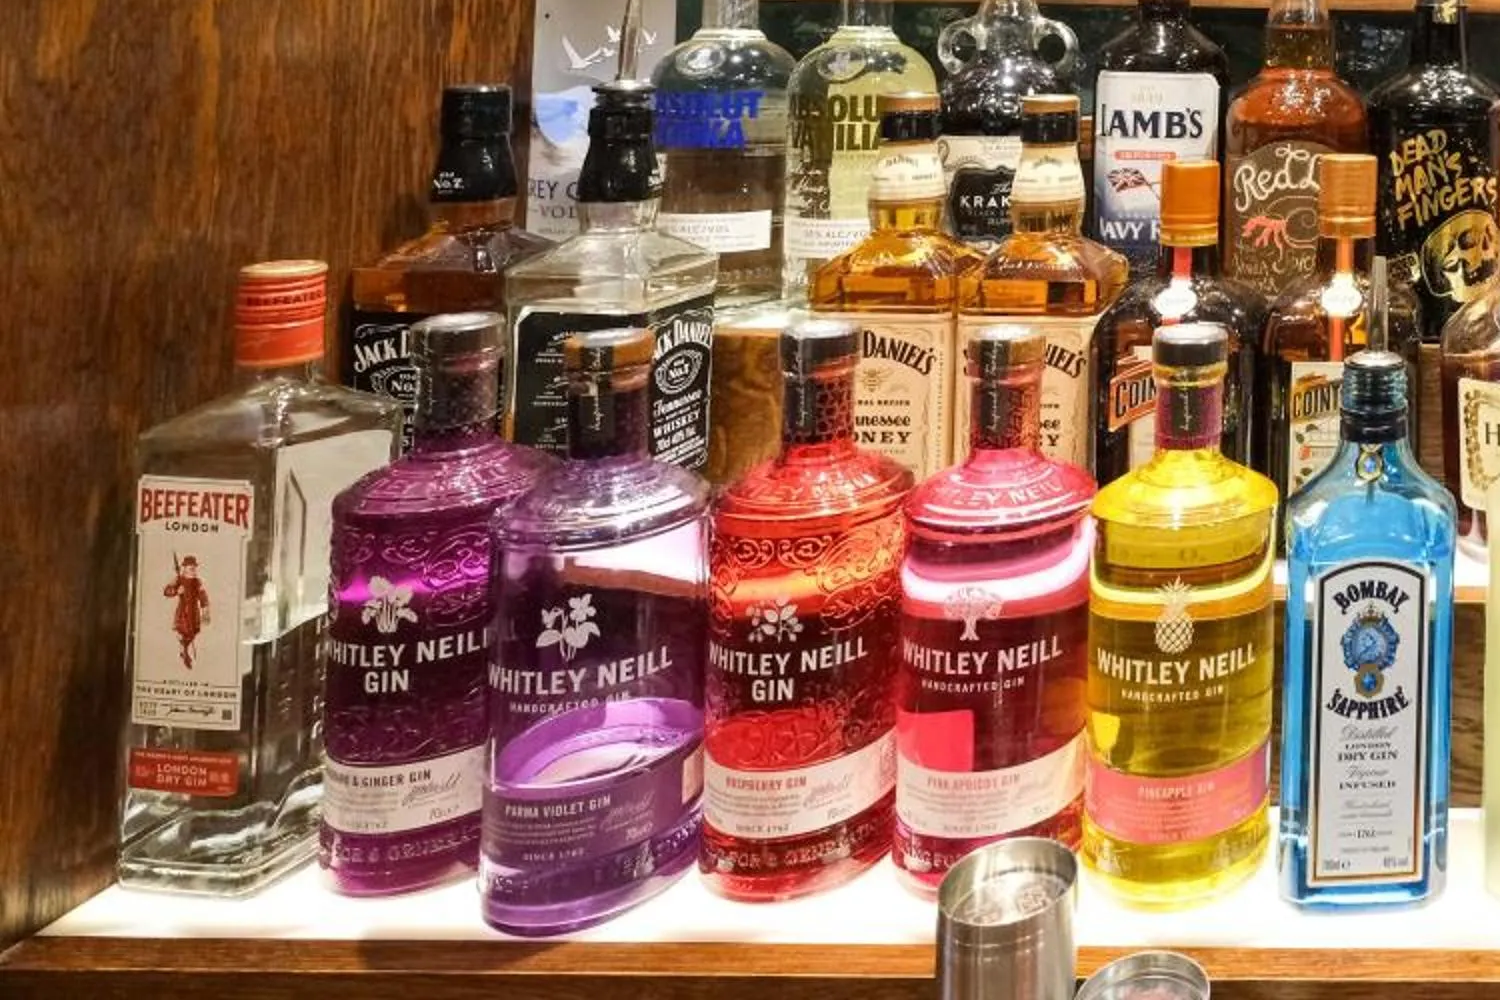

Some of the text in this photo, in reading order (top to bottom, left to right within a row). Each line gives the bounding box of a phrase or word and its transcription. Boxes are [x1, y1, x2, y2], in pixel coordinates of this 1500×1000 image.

[1101, 104, 1203, 139] LAMB'S
[1390, 129, 1447, 177] DEAD
[1234, 143, 1309, 213] Red
[1394, 151, 1461, 202] MAN'S
[959, 194, 1012, 208] KRAK
[1398, 176, 1498, 230] FINGERS
[353, 338, 398, 373] JACK
[863, 330, 937, 377] DANIEL'S
[1293, 382, 1342, 417] COINT
[653, 412, 699, 438] WHISKEY
[852, 432, 913, 446] NEY
[140, 487, 249, 530] BEEFEATER
[165, 521, 219, 533] LONDON
[1332, 579, 1411, 615] BOMBAY
[488, 646, 673, 696] WHITLEY NEILL
[709, 636, 868, 677] WHITLEY NEILL
[903, 635, 1064, 675] WHITLEY NEILL
[1097, 643, 1257, 685] WHITLEY NEILL
[364, 669, 410, 694] GIN
[751, 678, 794, 702] GIN
[922, 676, 1025, 693] HANDCRAFTED GIN
[1121, 688, 1199, 703] HANDCRAFTED
[1326, 686, 1411, 721] SAPPHIRE
[156, 763, 207, 776] LONDON
[1337, 750, 1398, 762] DRY GIN
[156, 773, 207, 787] DRY GIN
[361, 773, 404, 788] GINGER
[409, 768, 431, 784] GIN
[505, 795, 611, 818] PARMA VIOLET GIN
